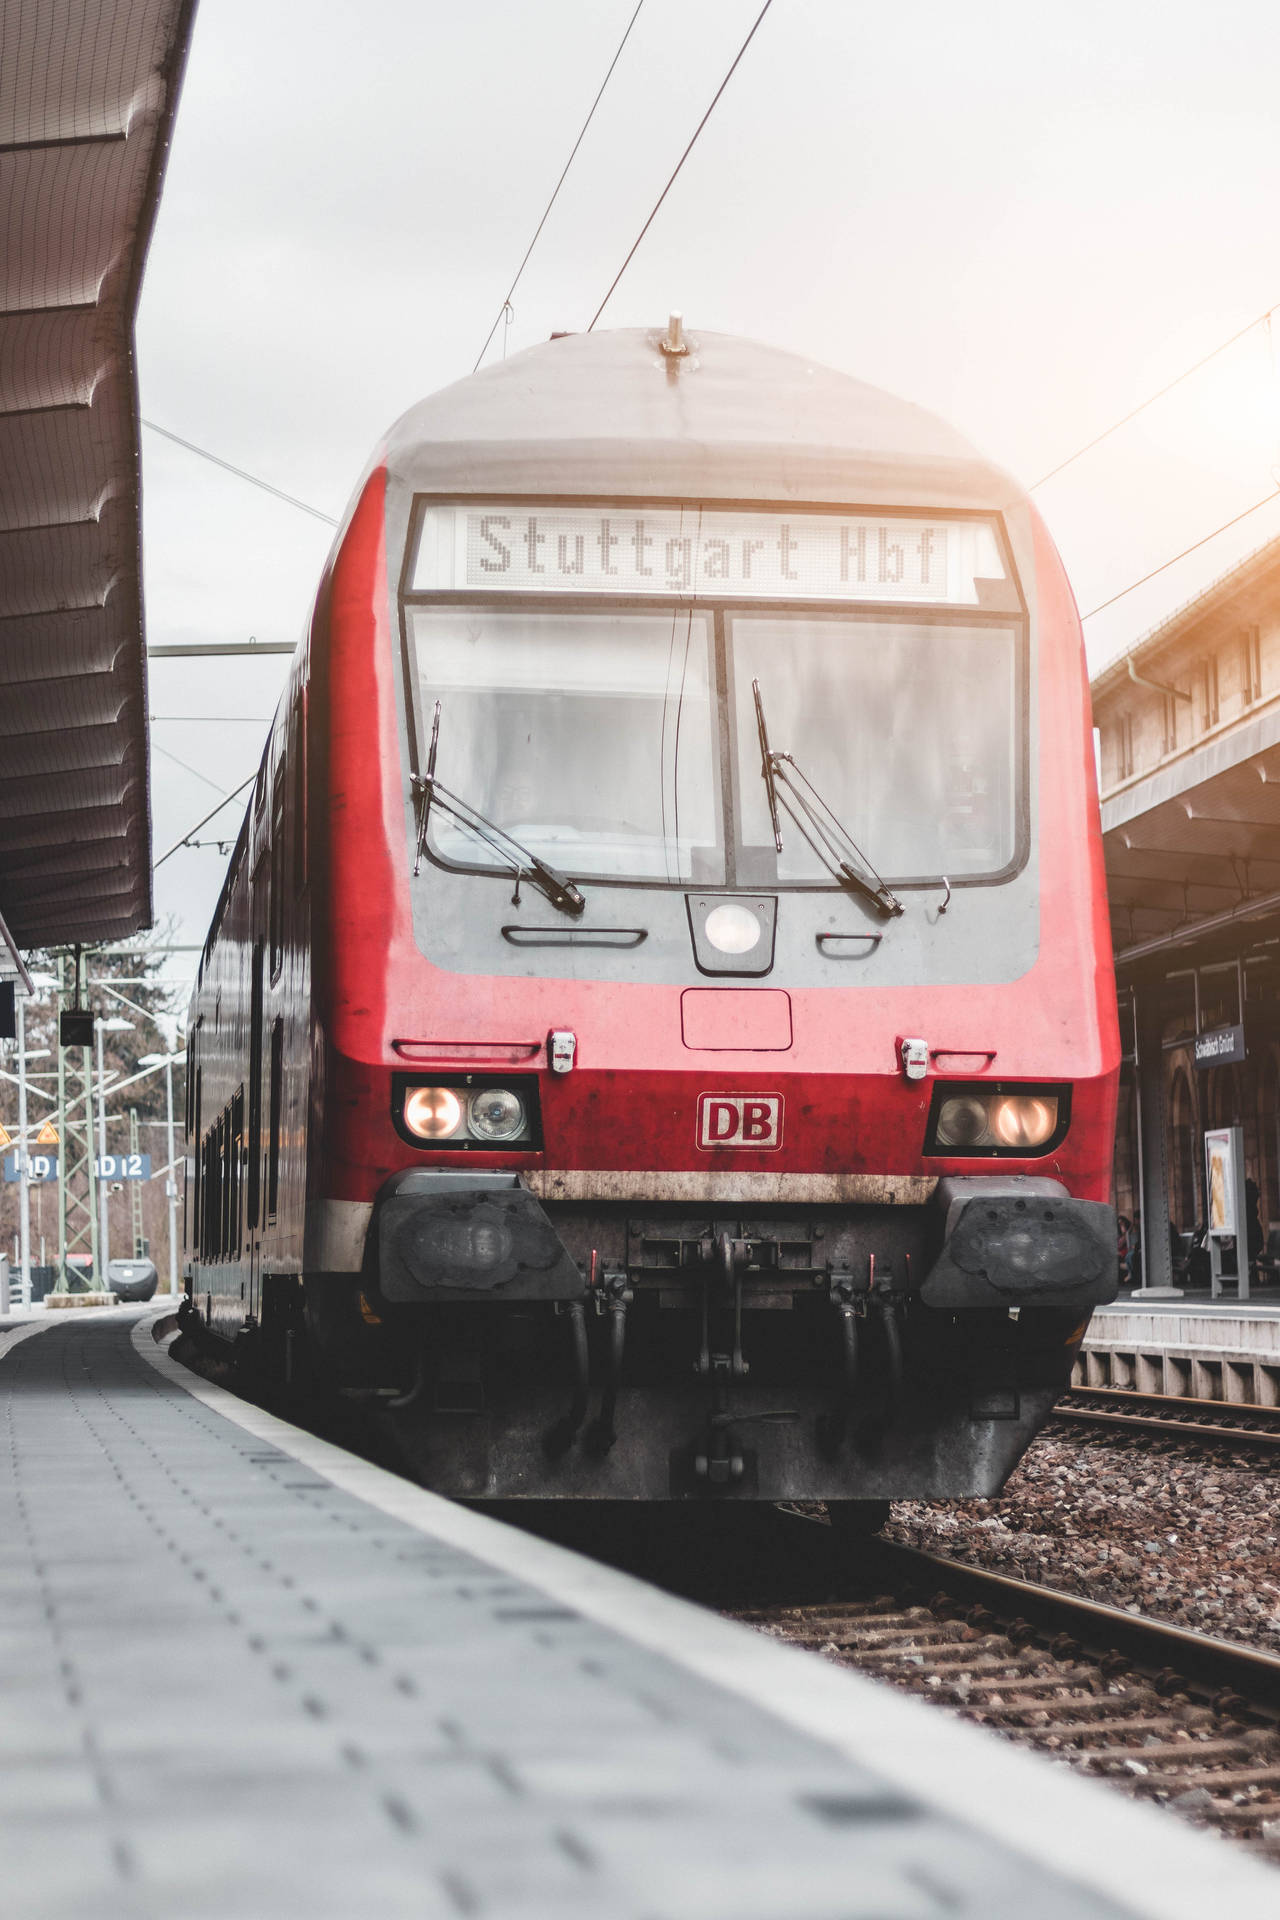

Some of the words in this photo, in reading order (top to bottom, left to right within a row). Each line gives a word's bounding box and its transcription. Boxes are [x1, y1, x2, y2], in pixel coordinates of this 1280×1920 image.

[479, 515, 798, 591] Stuttgart
[840, 525, 935, 584] Hbf
[707, 1102, 773, 1141] DB
